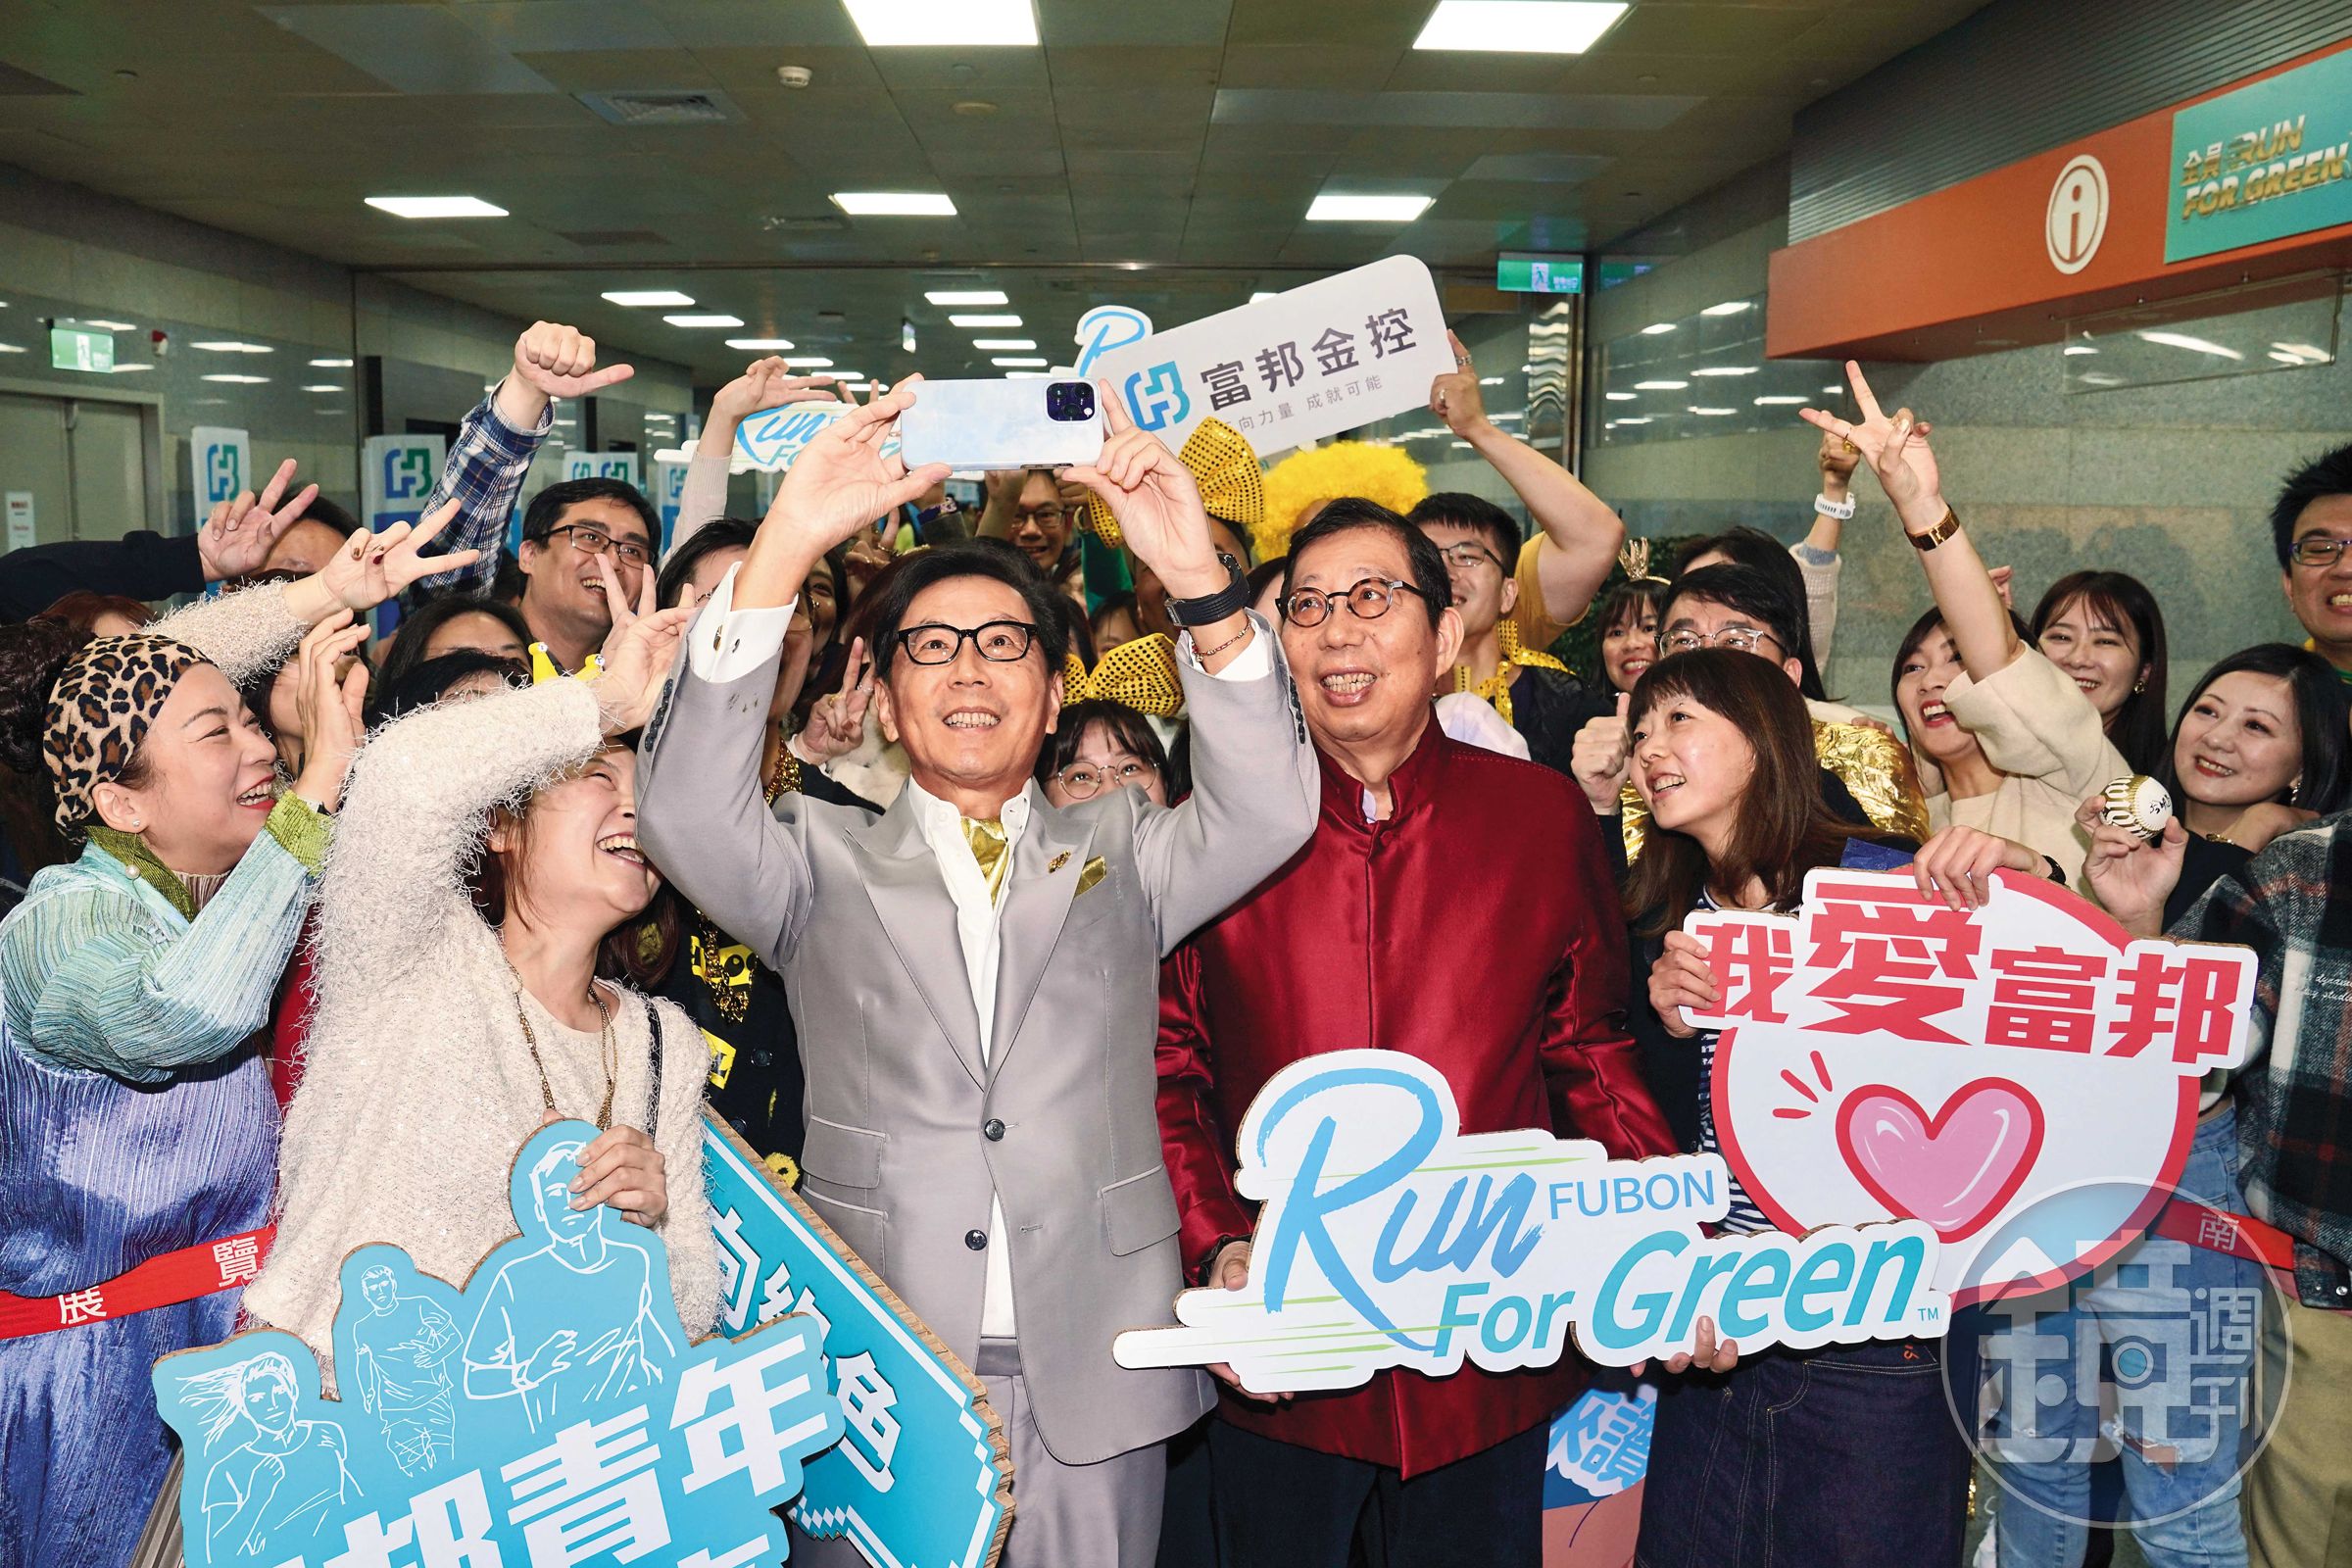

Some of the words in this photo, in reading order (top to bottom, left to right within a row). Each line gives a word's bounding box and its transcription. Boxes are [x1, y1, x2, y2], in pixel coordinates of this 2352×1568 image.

[2181, 175, 2239, 220] FOR
[2243, 142, 2349, 204] GREEN
[1200, 307, 1417, 412] 富邦金控
[1224, 401, 1294, 433] 向力量
[1306, 374, 1383, 410] 成就可能
[1693, 882, 2242, 1064] 我愛富邦
[1257, 1067, 1545, 1351] Run
[1548, 1170, 1714, 1221] FUBON
[2198, 1212, 2239, 1250] 南
[1433, 1282, 1574, 1357] For
[1592, 1229, 1925, 1354] Green
[272, 1334, 827, 1568] 邦青年
